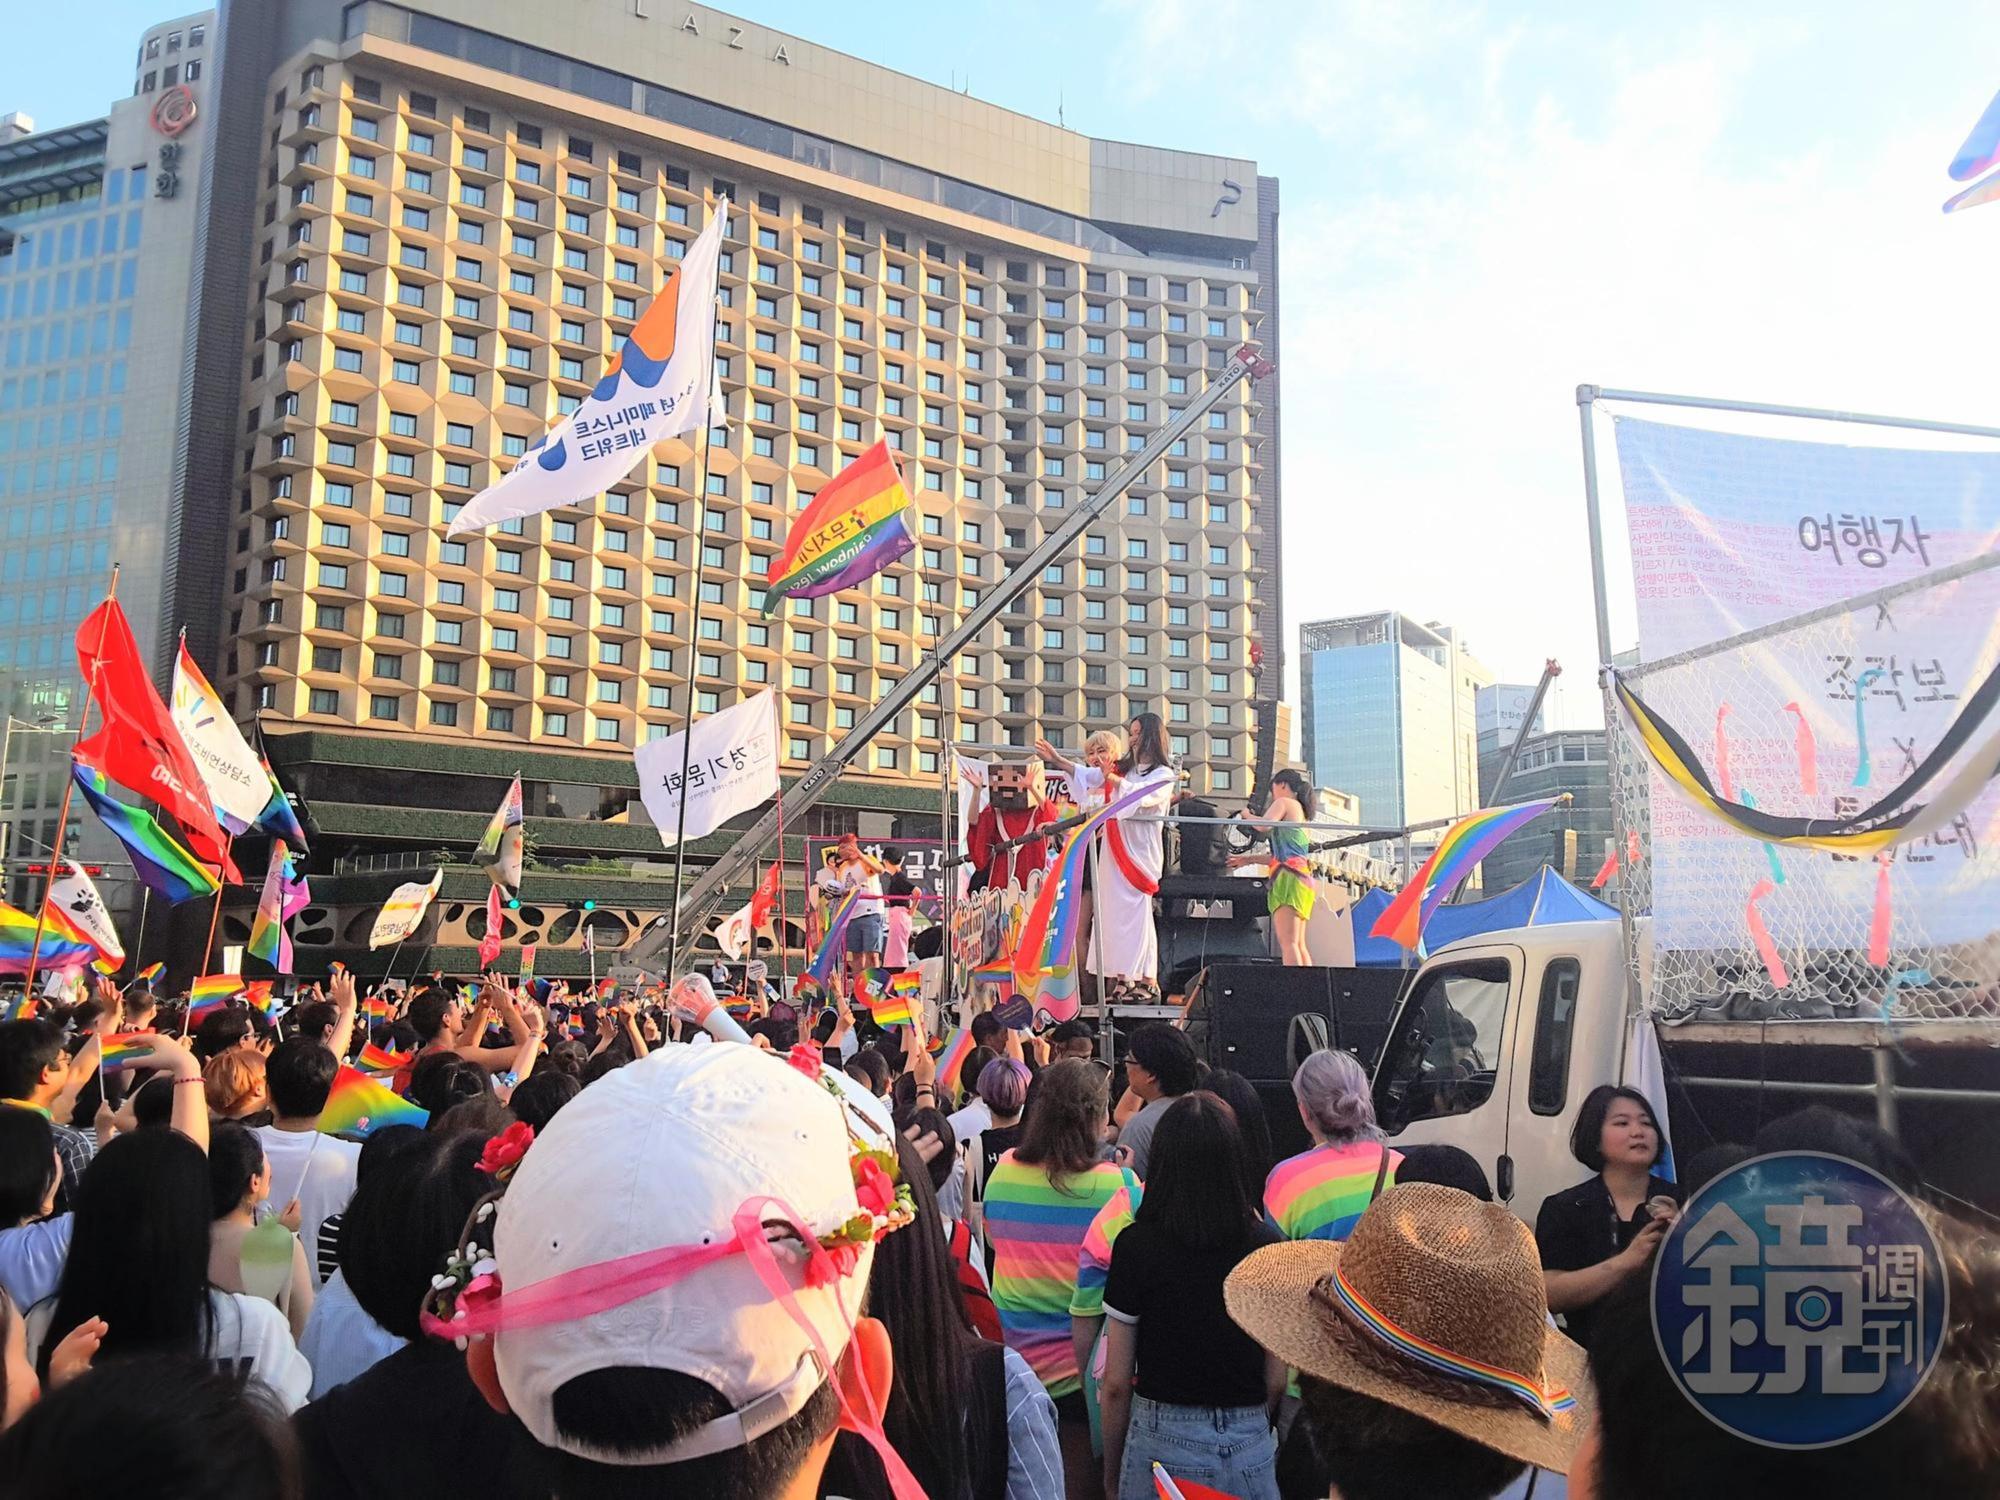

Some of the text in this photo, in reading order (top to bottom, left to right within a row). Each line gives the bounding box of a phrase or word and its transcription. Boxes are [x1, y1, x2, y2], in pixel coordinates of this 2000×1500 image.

[157, 142, 183, 198] 한화
[1217, 366, 1240, 388] KATO
[1798, 512, 1931, 568] 여행자
[1825, 654, 1961, 712] 조각보
[804, 769, 824, 790] KATO
